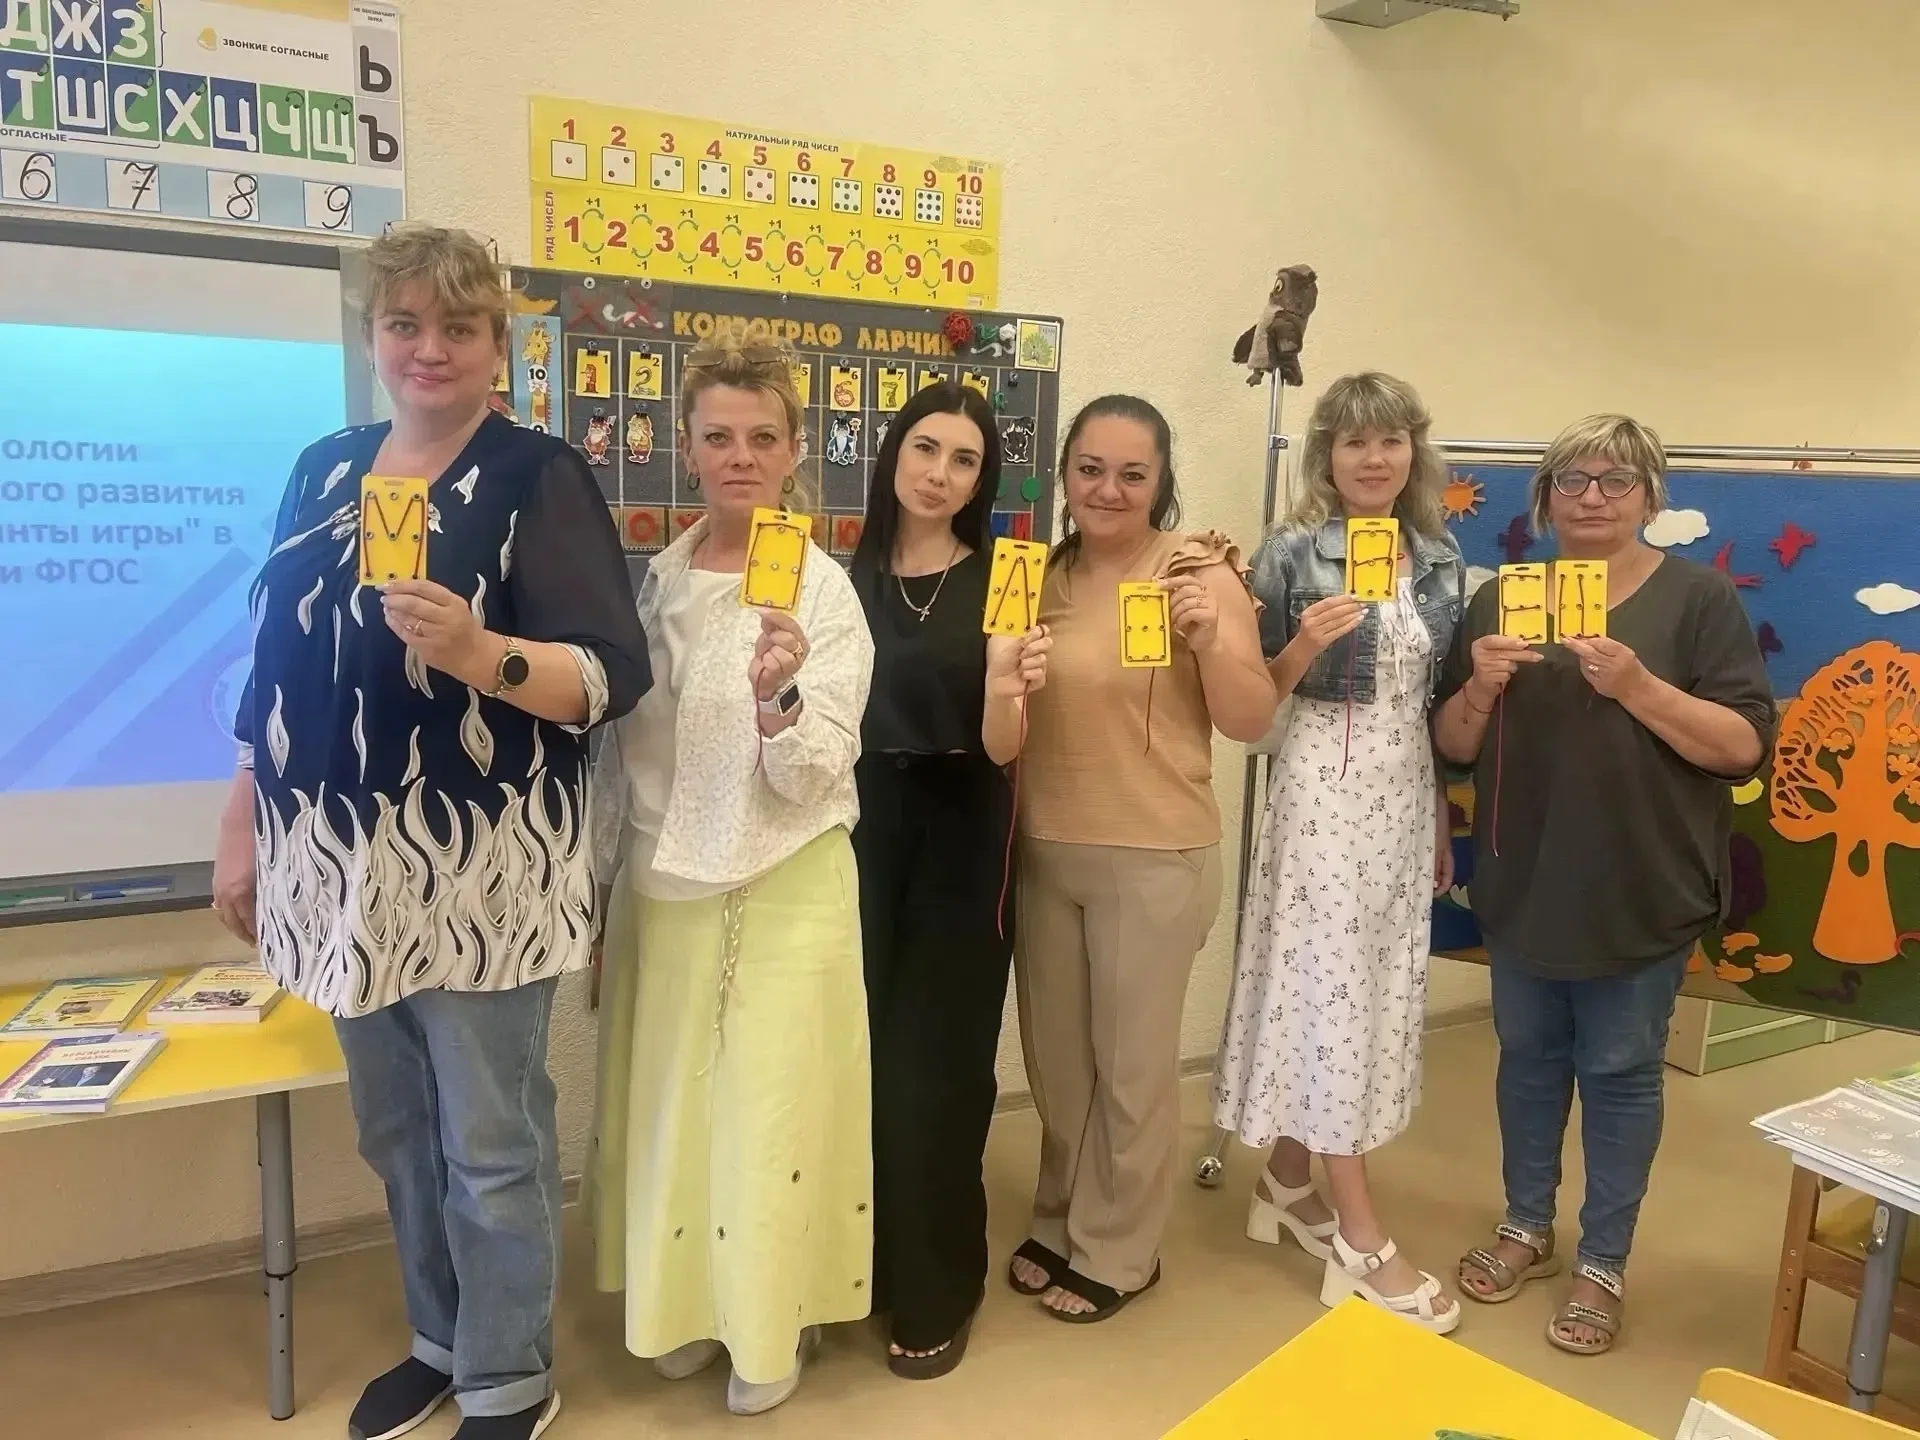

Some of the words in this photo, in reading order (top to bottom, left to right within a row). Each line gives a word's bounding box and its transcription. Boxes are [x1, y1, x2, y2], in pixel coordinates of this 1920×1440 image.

[0, 0, 48, 51] Д
[52, 0, 102, 54] Ж
[111, 8, 149, 59] З
[222, 38, 268, 52] ЗВОНКИЕ
[270, 45, 330, 61] СОГЛАСНЫЕ
[359, 44, 393, 93] Ь
[6, 69, 46, 121] Т
[57, 75, 106, 129] Ш
[113, 83, 150, 133] С
[165, 88, 204, 140] Х
[214, 94, 257, 152] Ц
[266, 101, 301, 152] Ч
[312, 107, 355, 164] Щ
[0, 127, 68, 143] ОГЛАСНЫЕ
[358, 113, 399, 163] Ъ
[725, 129, 791, 147] НАТУРАЛЬНЫЙ
[791, 139, 809, 150] РЯД
[810, 143, 840, 153] ЧИСЕЛ
[562, 118, 575, 140] 1
[610, 125, 627, 148] 2
[659, 132, 676, 154] 3
[705, 139, 723, 160] 4
[752, 145, 768, 166] 5
[797, 151, 812, 172] 6
[840, 157, 855, 178] 7
[882, 164, 897, 183] 8
[923, 169, 937, 189] 9
[956, 173, 983, 195] 10
[20, 152, 55, 200] 6
[122, 161, 158, 209] 7
[226, 173, 258, 220] 8
[321, 184, 352, 229] 9
[544, 190, 554, 232] ЧИСЕЛ
[586, 197, 601, 208] +1
[633, 203, 648, 213] +1
[679, 208, 694, 218] +1
[725, 214, 739, 224] +1
[768, 219, 782, 229] +1
[808, 224, 822, 234] +1
[849, 229, 862, 239] +1
[887, 233, 901, 243] +1
[926, 238, 939, 248] +1
[545, 234, 555, 261] РЯД
[563, 215, 580, 243] 1
[606, 220, 628, 249] 2
[655, 226, 675, 253] 3
[699, 231, 720, 258] 4
[744, 236, 764, 262] 5
[786, 241, 805, 267] 6
[827, 246, 845, 271] 7
[865, 250, 883, 275] 8
[905, 254, 922, 279] 9
[941, 258, 975, 285] 10
[589, 255, 601, 266] -1
[636, 261, 648, 271] -1
[683, 265, 694, 275] -1
[728, 270, 739, 280] -1
[771, 274, 781, 284] -1
[811, 278, 821, 288] -1
[851, 282, 860, 292] -1
[889, 286, 899, 296] -1
[927, 290, 938, 300] -1
[603, 355, 609, 365] 1
[652, 357, 660, 367] 2
[801, 367, 809, 377] 5
[529, 368, 546, 380] 10
[851, 369, 859, 380] 6
[897, 371, 904, 381] 7
[980, 379, 987, 388] 9
[1, 438, 139, 463] ологии
[1, 480, 65, 503] ого
[77, 484, 246, 510] развития
[0, 523, 79, 544] нты
[35, 557, 141, 585] ФГОС
